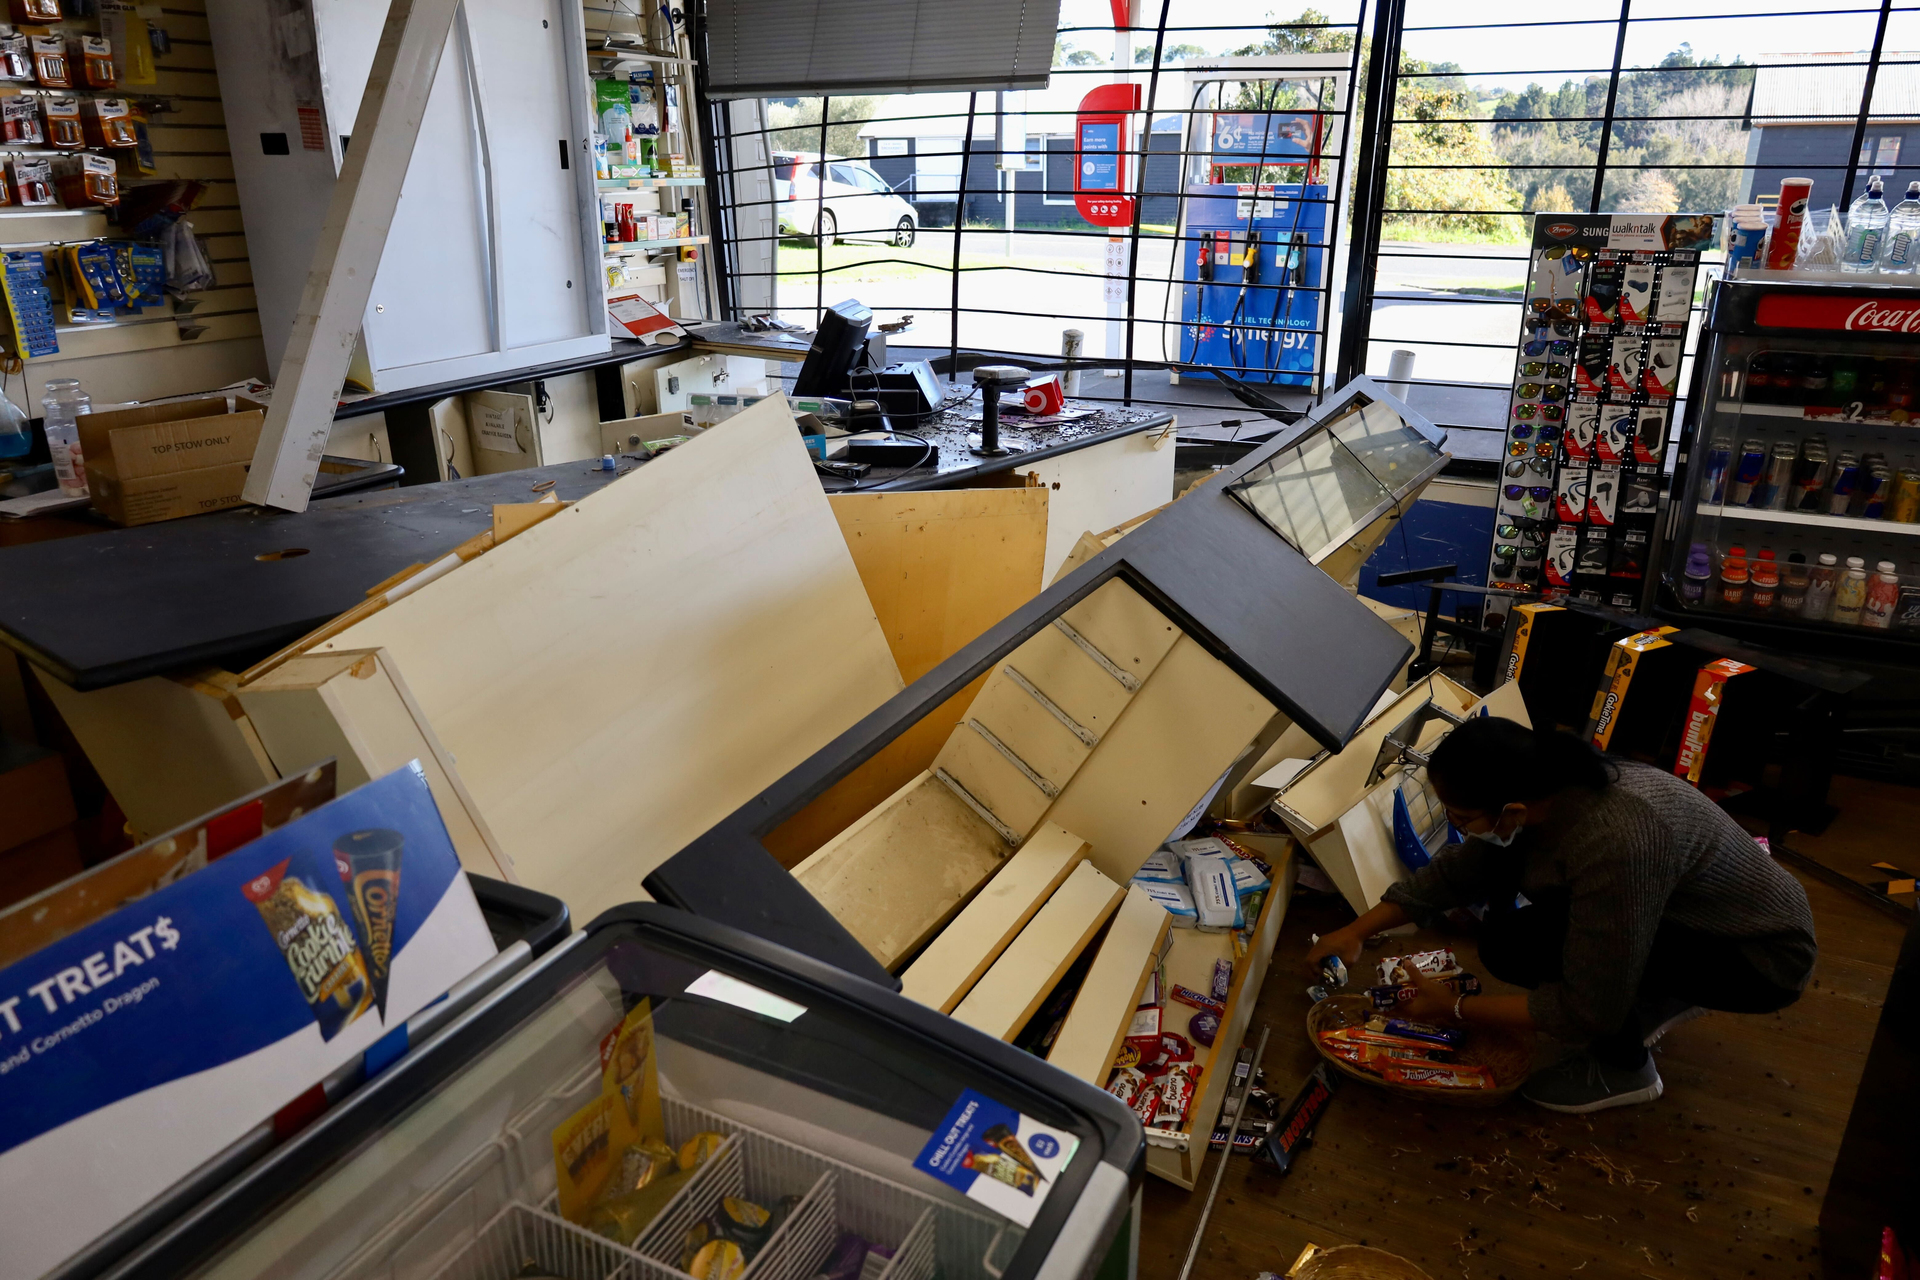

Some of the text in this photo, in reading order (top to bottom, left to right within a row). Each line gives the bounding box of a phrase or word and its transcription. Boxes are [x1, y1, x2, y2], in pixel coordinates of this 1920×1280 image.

[5, 102, 36, 116] Energizer
[17, 164, 49, 179] Energizer
[89, 163, 110, 171] PHILIPS
[1612, 223, 1656, 234] walkntalk
[1861, 233, 1879, 262] pump
[1892, 233, 1912, 263] pump
[1222, 319, 1309, 350] Synergy
[152, 436, 231, 455] TOP STOW ONLY
[198, 499, 217, 508] TOP
[1595, 692, 1619, 734] CookieTime
[354, 870, 400, 978] Cornetto
[286, 913, 340, 972] Cookie
[31, 1008, 104, 1054] Cornetto
[103, 977, 160, 1015] Dragon
[1115, 1083, 1126, 1099] ueno
[1166, 1077, 1177, 1101] bueno
[1279, 1080, 1329, 1153] TOBLERONE
[929, 1143, 951, 1167] CHILL
[944, 1128, 961, 1145] OUT
[1211, 1132, 1252, 1144] SNIKER
